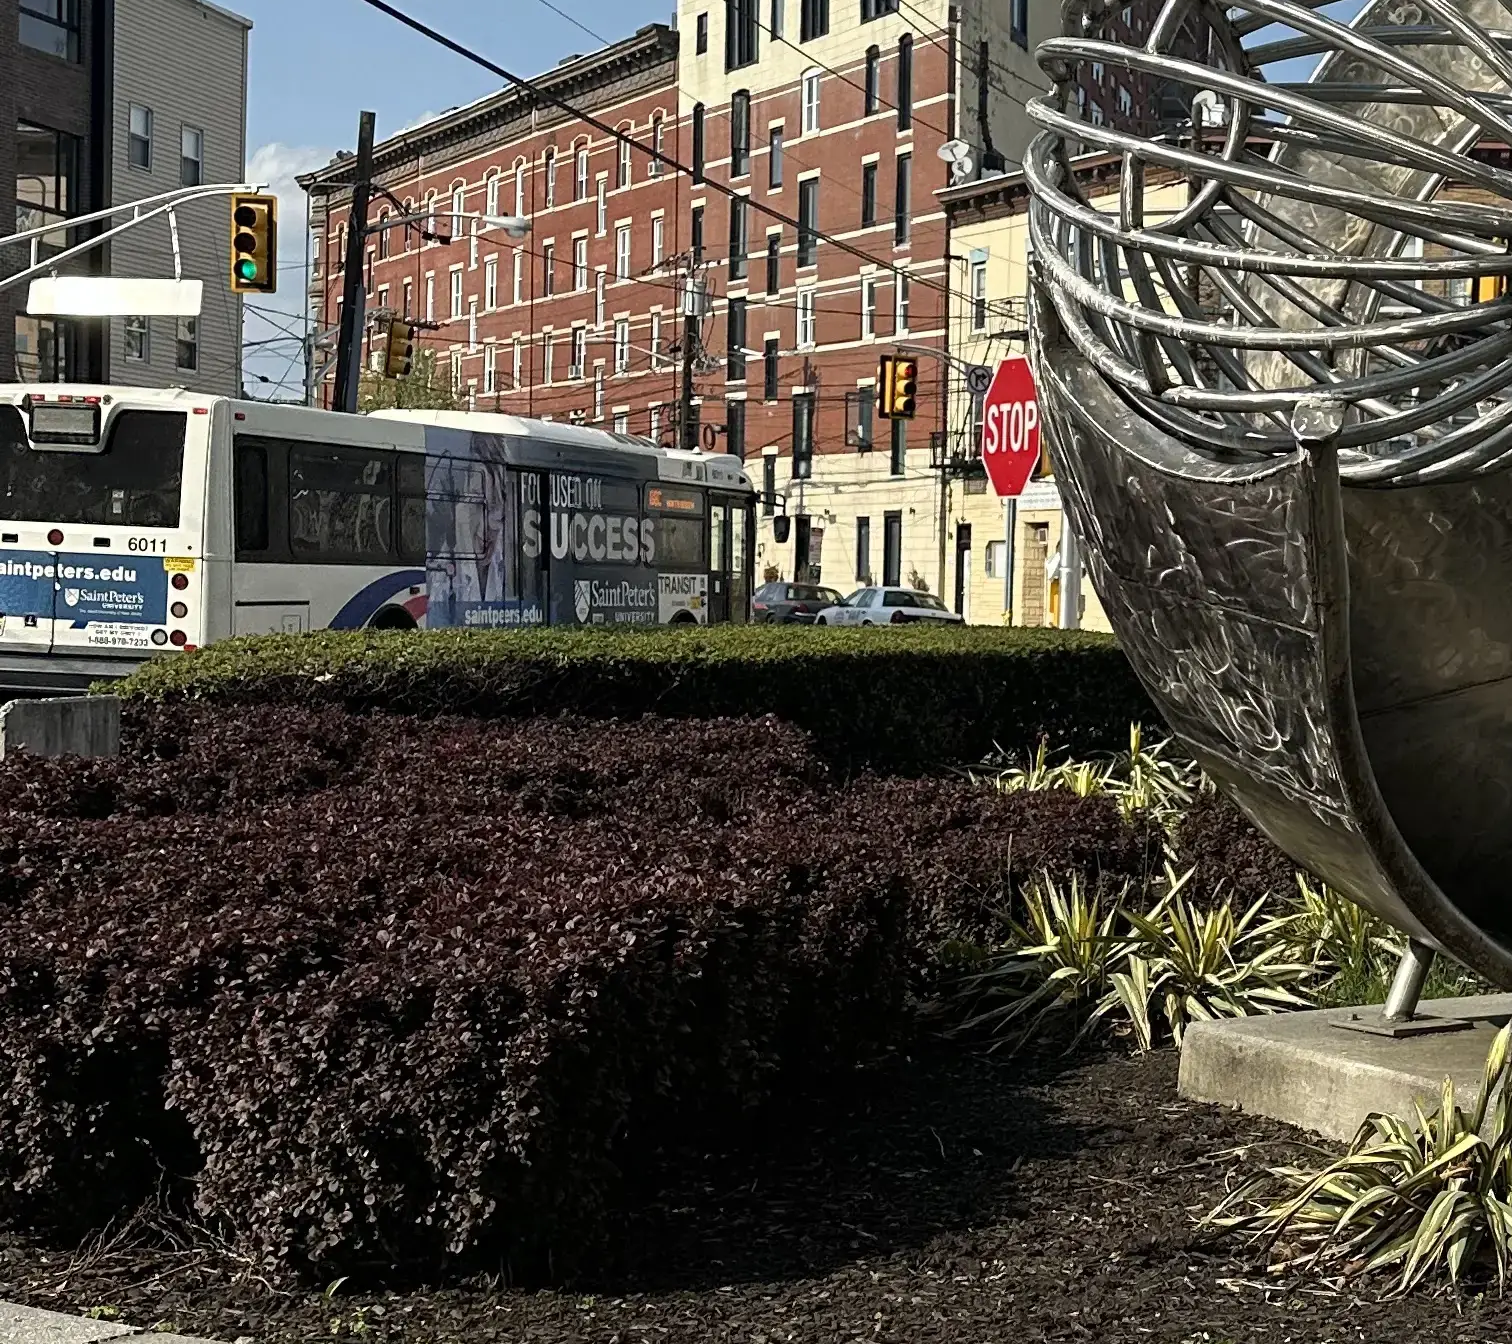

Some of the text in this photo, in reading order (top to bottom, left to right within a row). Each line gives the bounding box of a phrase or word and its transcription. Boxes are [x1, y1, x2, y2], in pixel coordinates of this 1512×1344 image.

[985, 399, 1038, 455] STOP
[128, 537, 167, 553] 6011
[522, 508, 656, 563] SUCCESS
[0, 559, 137, 582] aintpeters.edu
[658, 576, 697, 595] TRANSIT
